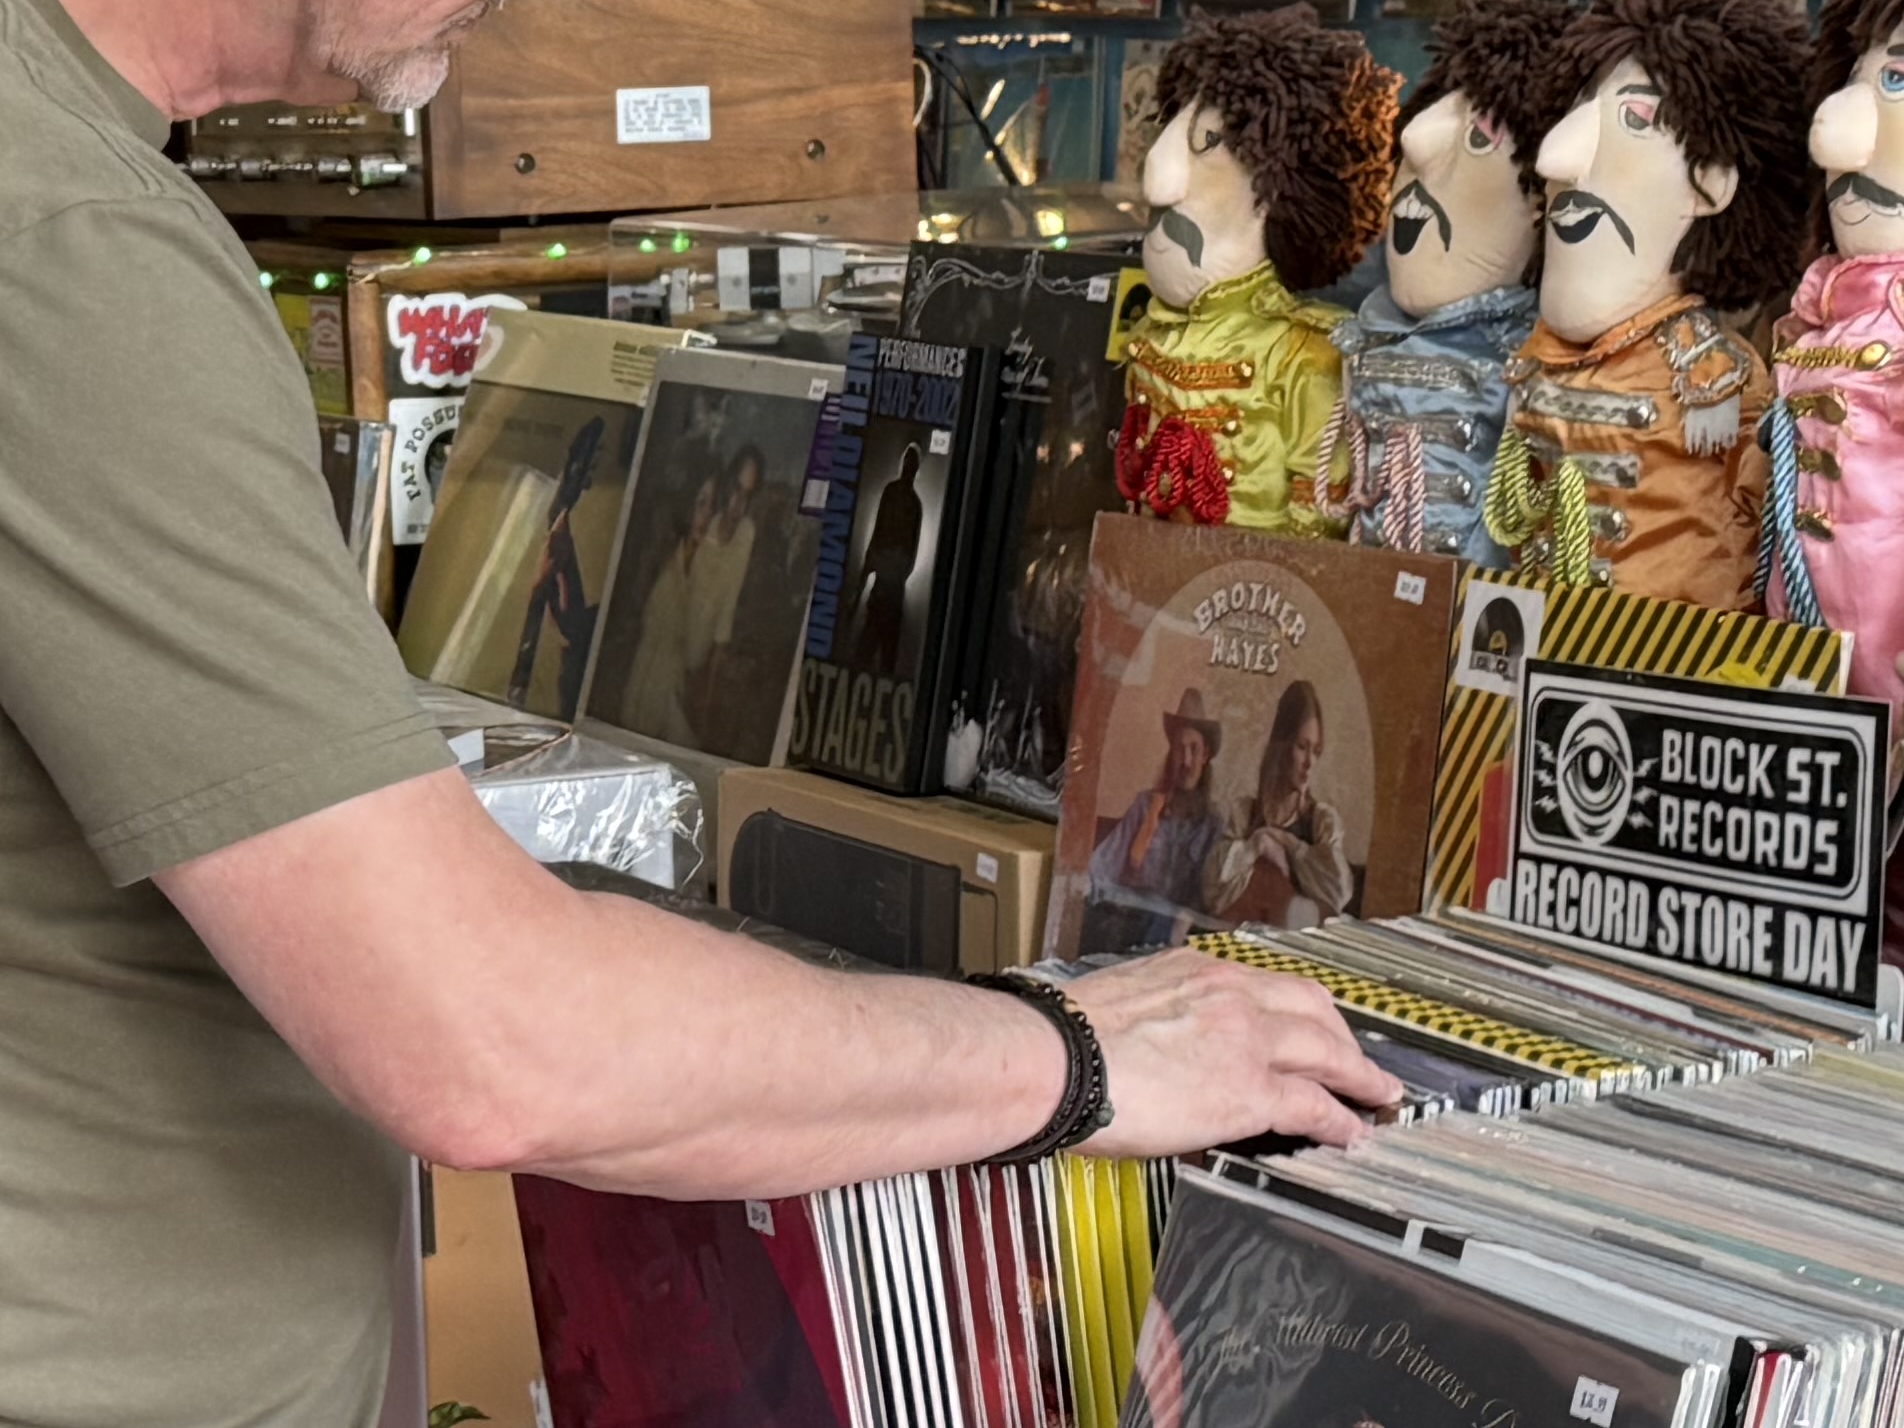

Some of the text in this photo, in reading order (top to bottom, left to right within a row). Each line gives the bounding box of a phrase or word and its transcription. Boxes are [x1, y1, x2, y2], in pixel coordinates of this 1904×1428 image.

[877, 337, 968, 378] PERFORMANCES
[404, 403, 464, 454] POSSU
[876, 372, 964, 426] 1970-2002
[804, 335, 878, 660] NEIL DIAMOND
[1193, 581, 1308, 647] BROTHER
[1209, 634, 1281, 675] HAYES
[789, 656, 919, 786] STAGES
[1660, 728, 1848, 809] BLOCK ST.
[1658, 795, 1840, 877] RECORDS
[1513, 857, 1867, 994] RECORD STORE DAY
[1369, 1317, 1478, 1411] Princess
